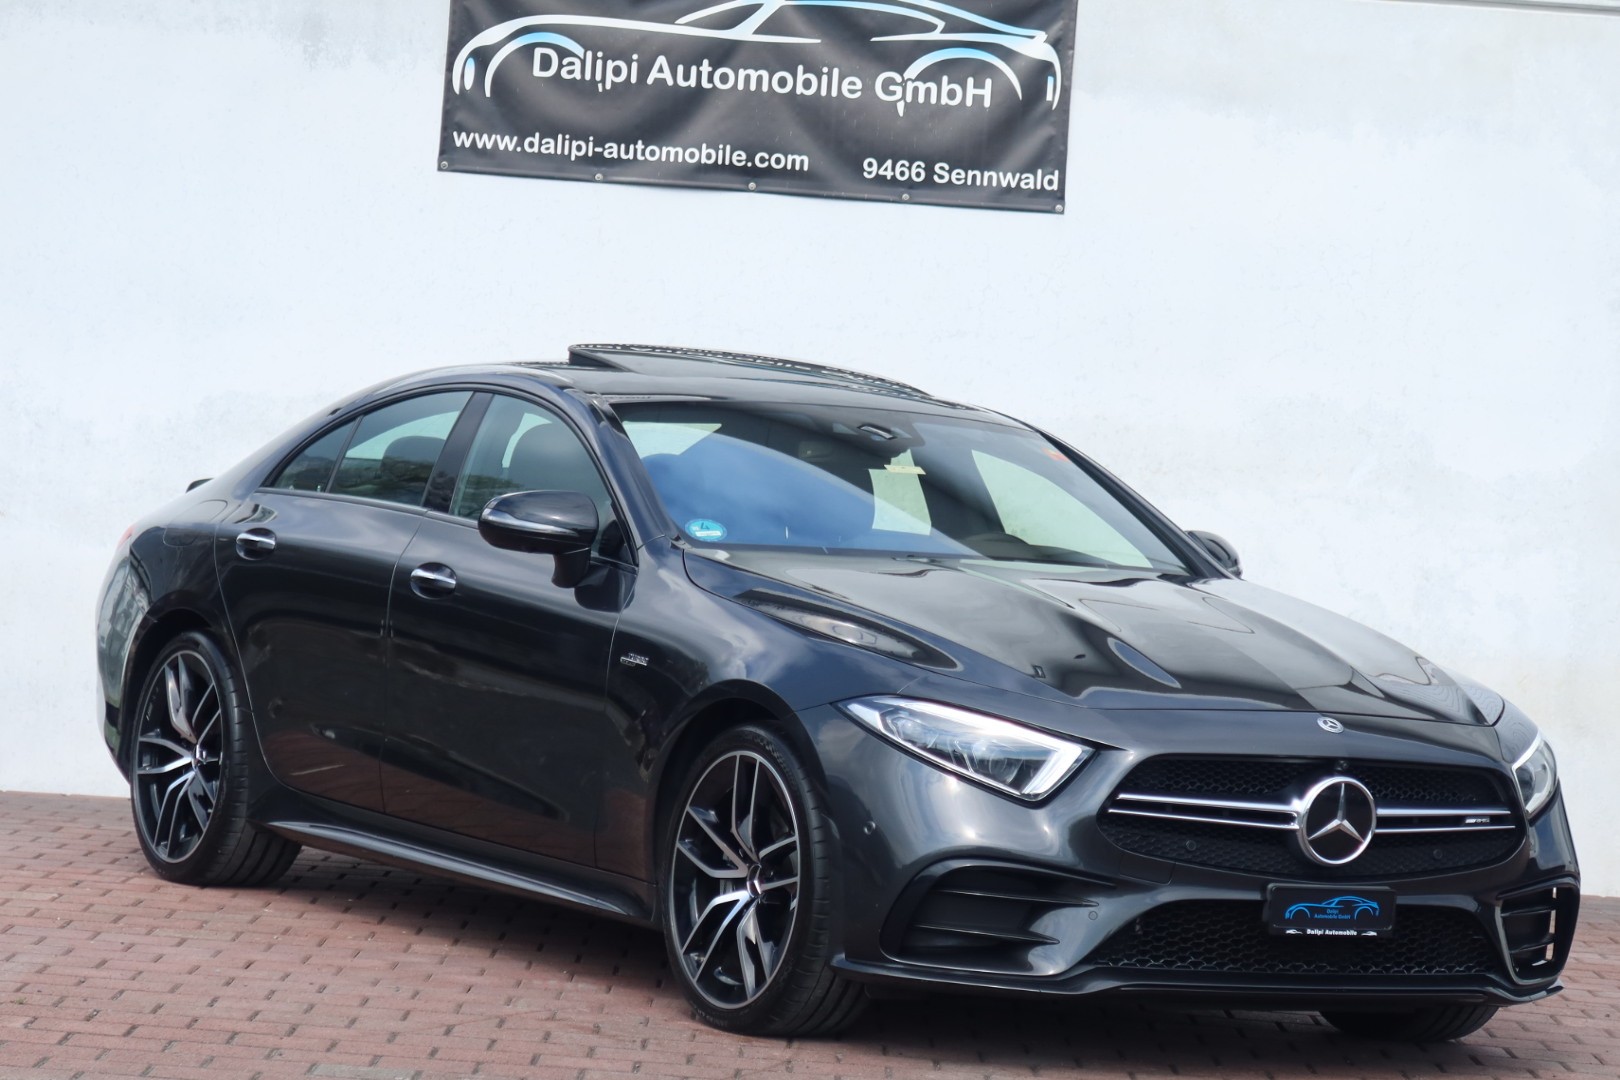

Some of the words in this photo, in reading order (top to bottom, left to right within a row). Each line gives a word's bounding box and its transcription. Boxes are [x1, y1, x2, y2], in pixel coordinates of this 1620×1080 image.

[532, 47, 639, 90] Dalipi
[646, 55, 863, 99] Automobile
[874, 71, 993, 108] GmbH
[452, 131, 809, 171] www.dalipi-automobile.com
[862, 157, 926, 182] 9466
[932, 162, 1059, 191] Sennwald
